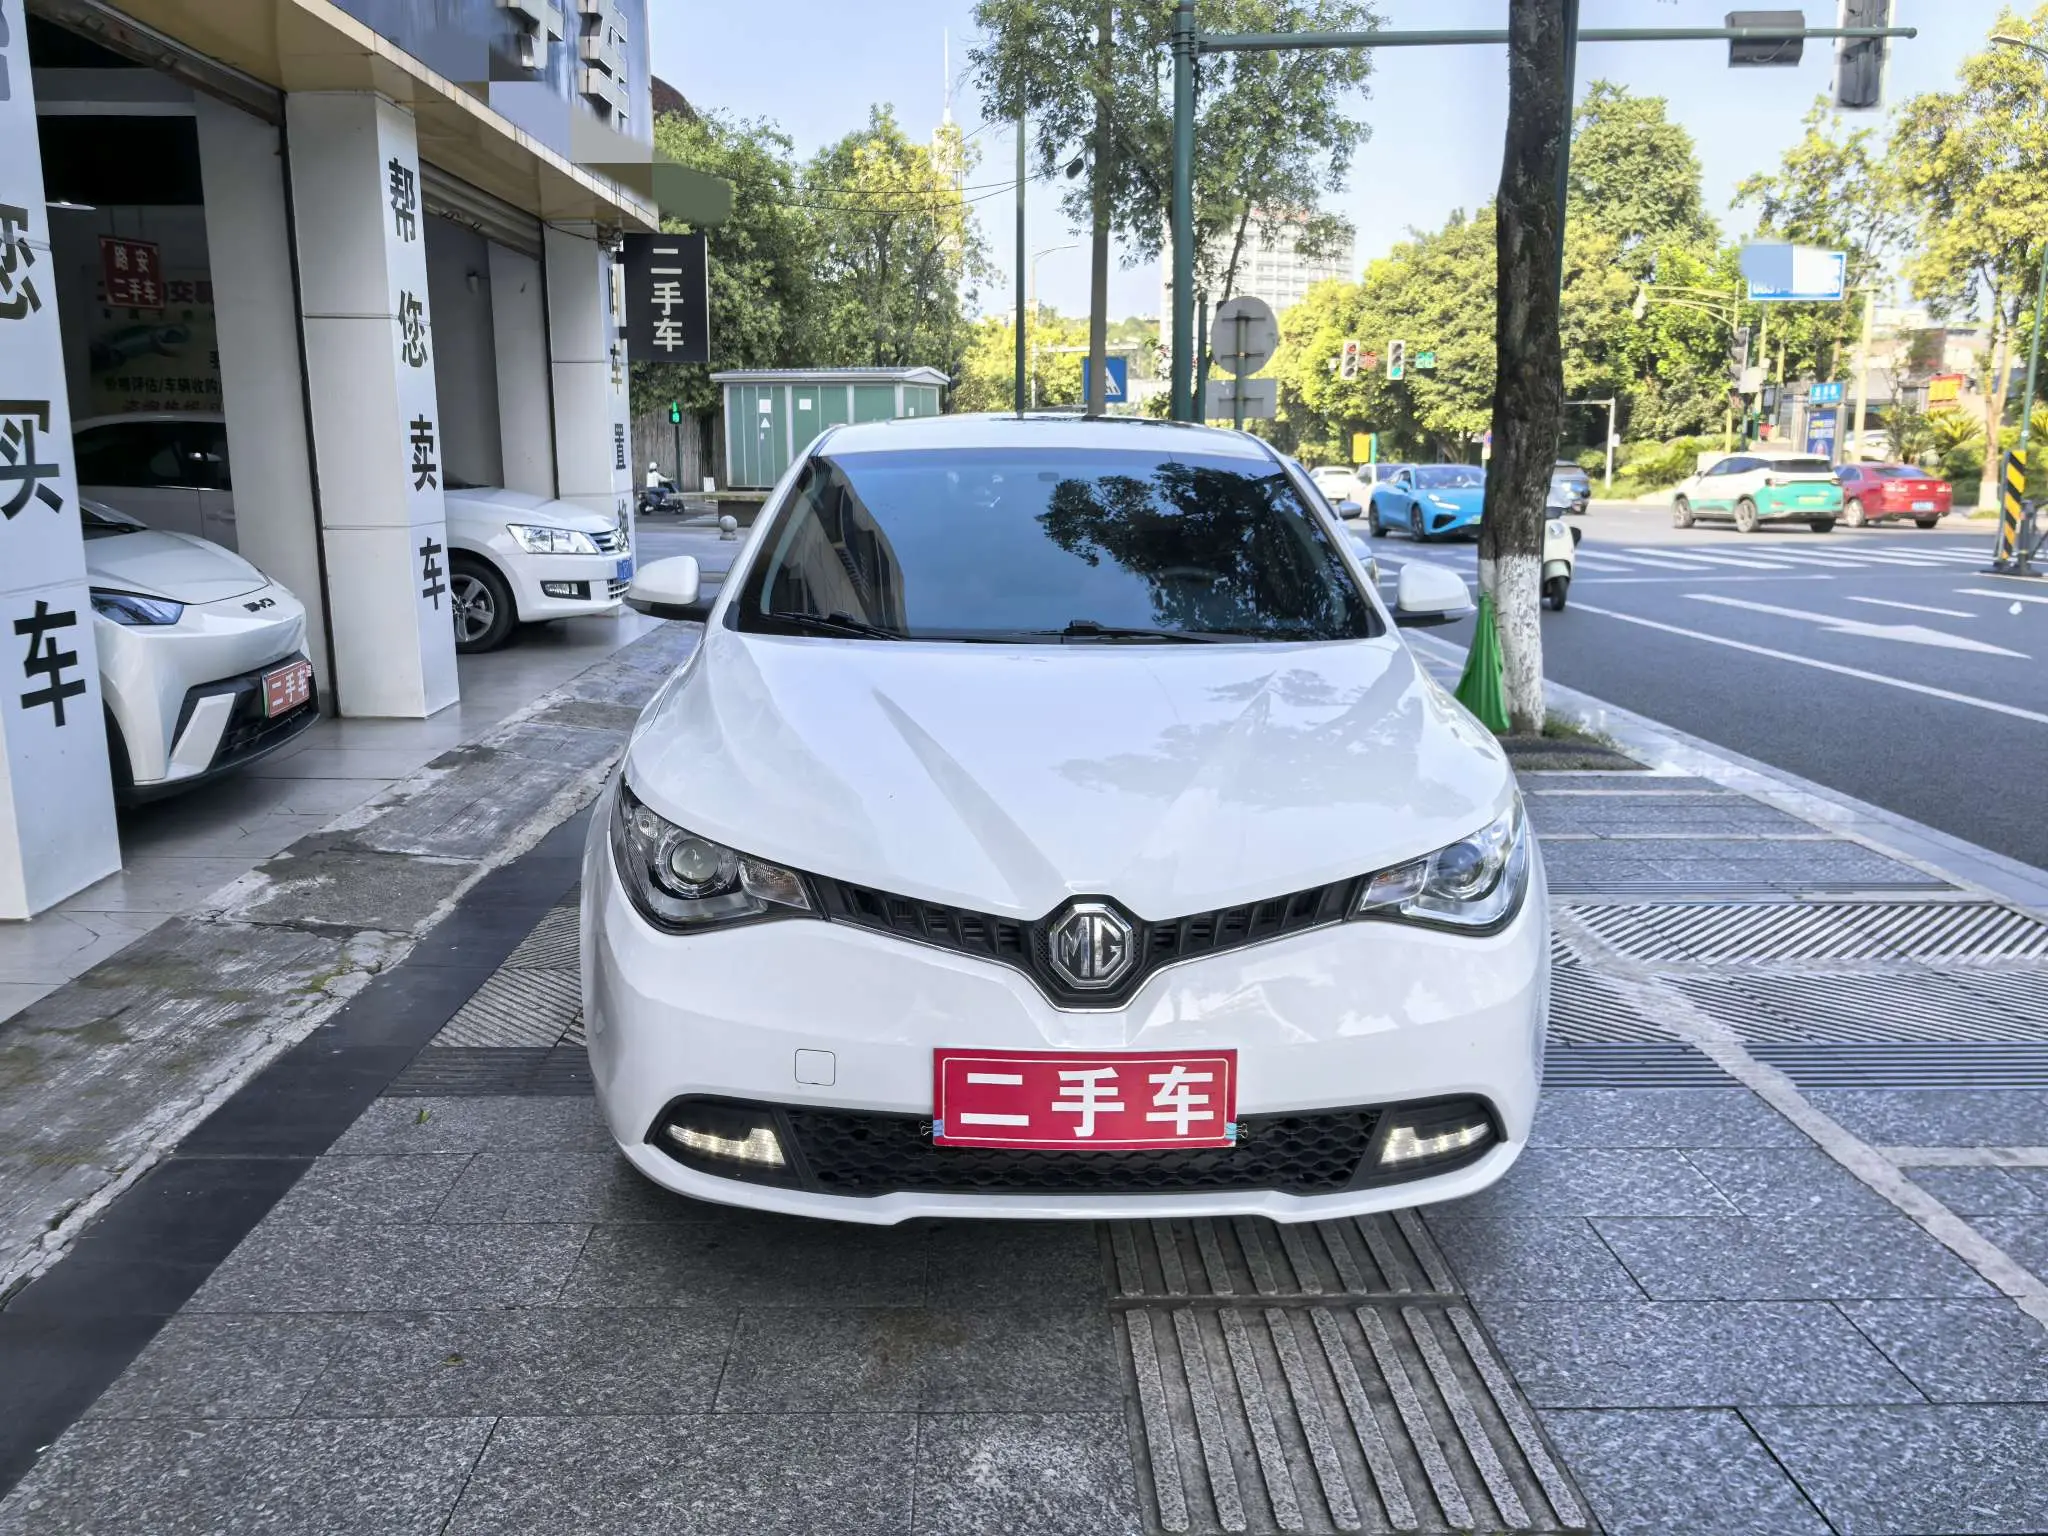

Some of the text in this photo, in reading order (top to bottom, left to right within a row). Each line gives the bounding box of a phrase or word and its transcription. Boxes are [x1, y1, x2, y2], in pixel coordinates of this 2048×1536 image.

[113, 277, 158, 304] 二手车
[650, 246, 684, 353] 二手车
[388, 156, 447, 611] 帮您卖车
[271, 666, 307, 703] 二手车
[1059, 914, 1127, 979] MG
[960, 1065, 1215, 1138] 二手车
